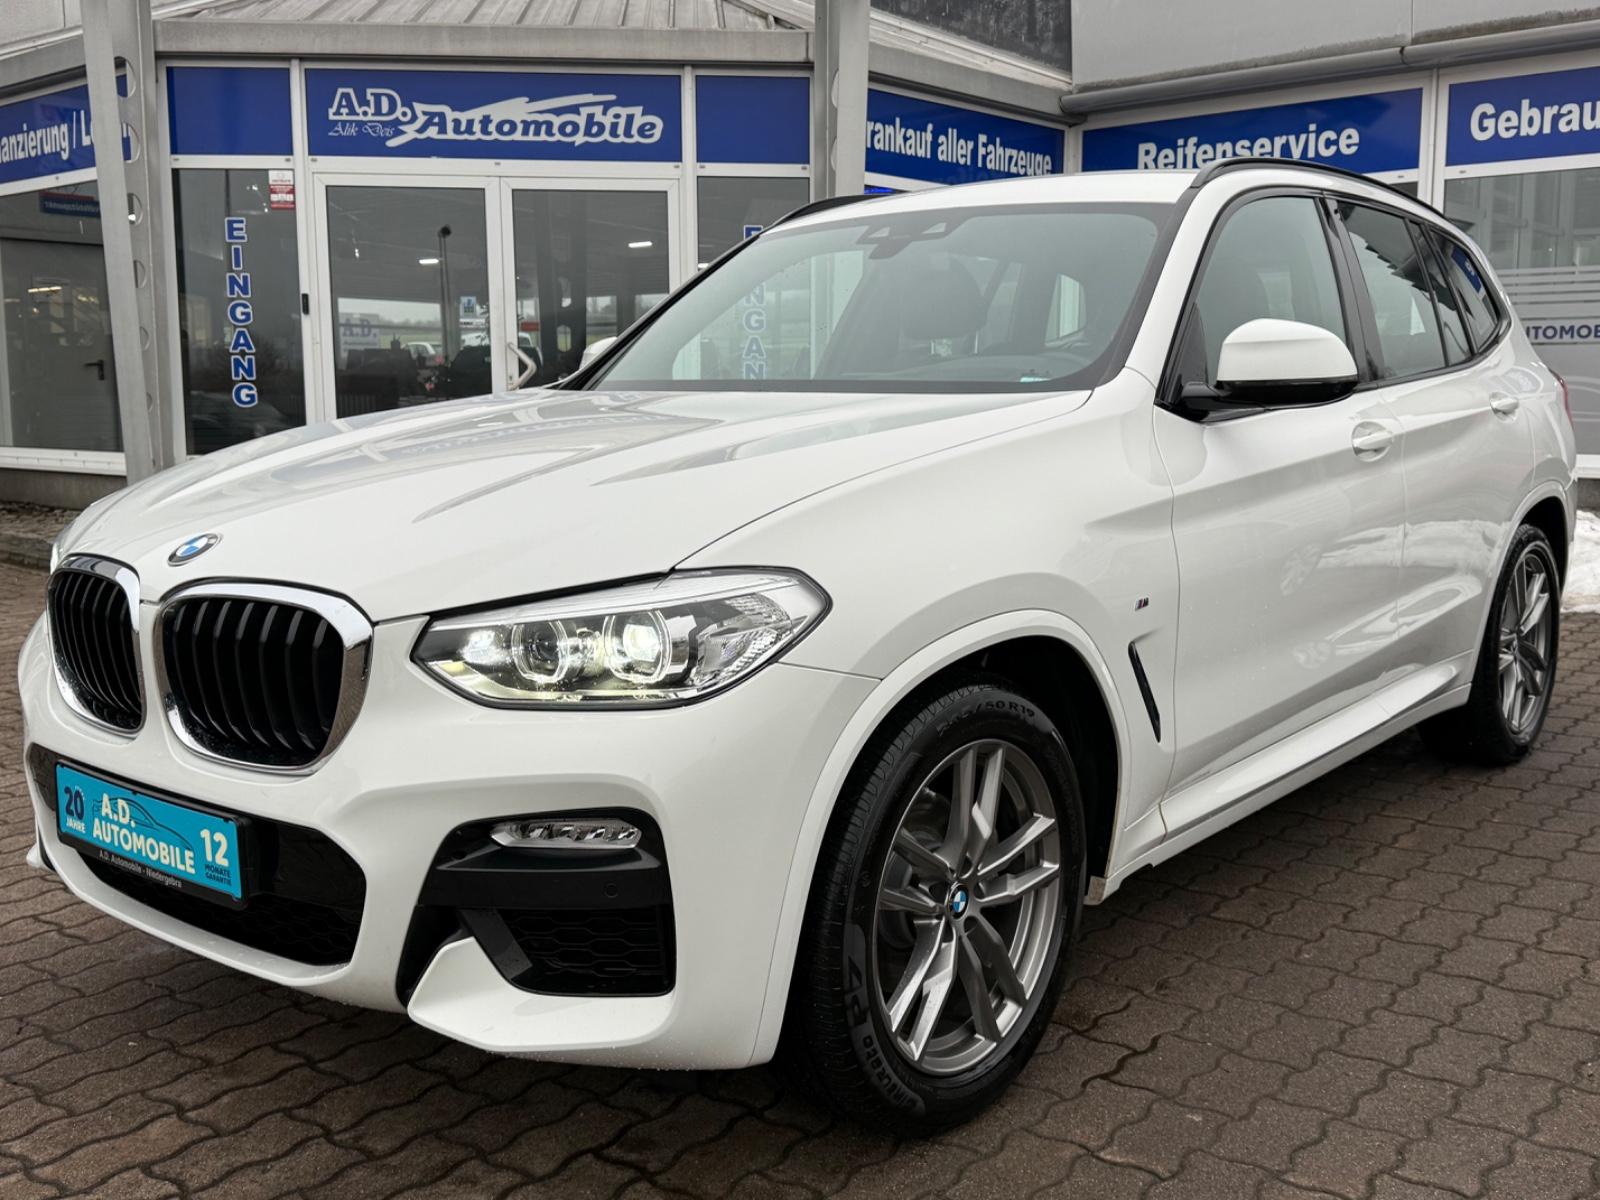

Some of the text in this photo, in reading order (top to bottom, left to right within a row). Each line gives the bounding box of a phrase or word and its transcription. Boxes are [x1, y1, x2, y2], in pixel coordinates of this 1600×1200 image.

[328, 87, 663, 143] A.D. Automobile
[1470, 98, 1600, 141] Gebrau
[0, 122, 69, 163] anzierung
[938, 128, 974, 166] aller
[978, 133, 1052, 176] Fahrzeuge
[1137, 123, 1361, 170] Reifenservice
[225, 217, 258, 408] EINGANG
[64, 786, 85, 820] 20
[101, 793, 136, 828] A.D.
[66, 816, 86, 834] JAHRE
[93, 818, 196, 875] AUTOMOBILE
[200, 828, 229, 867] 12
